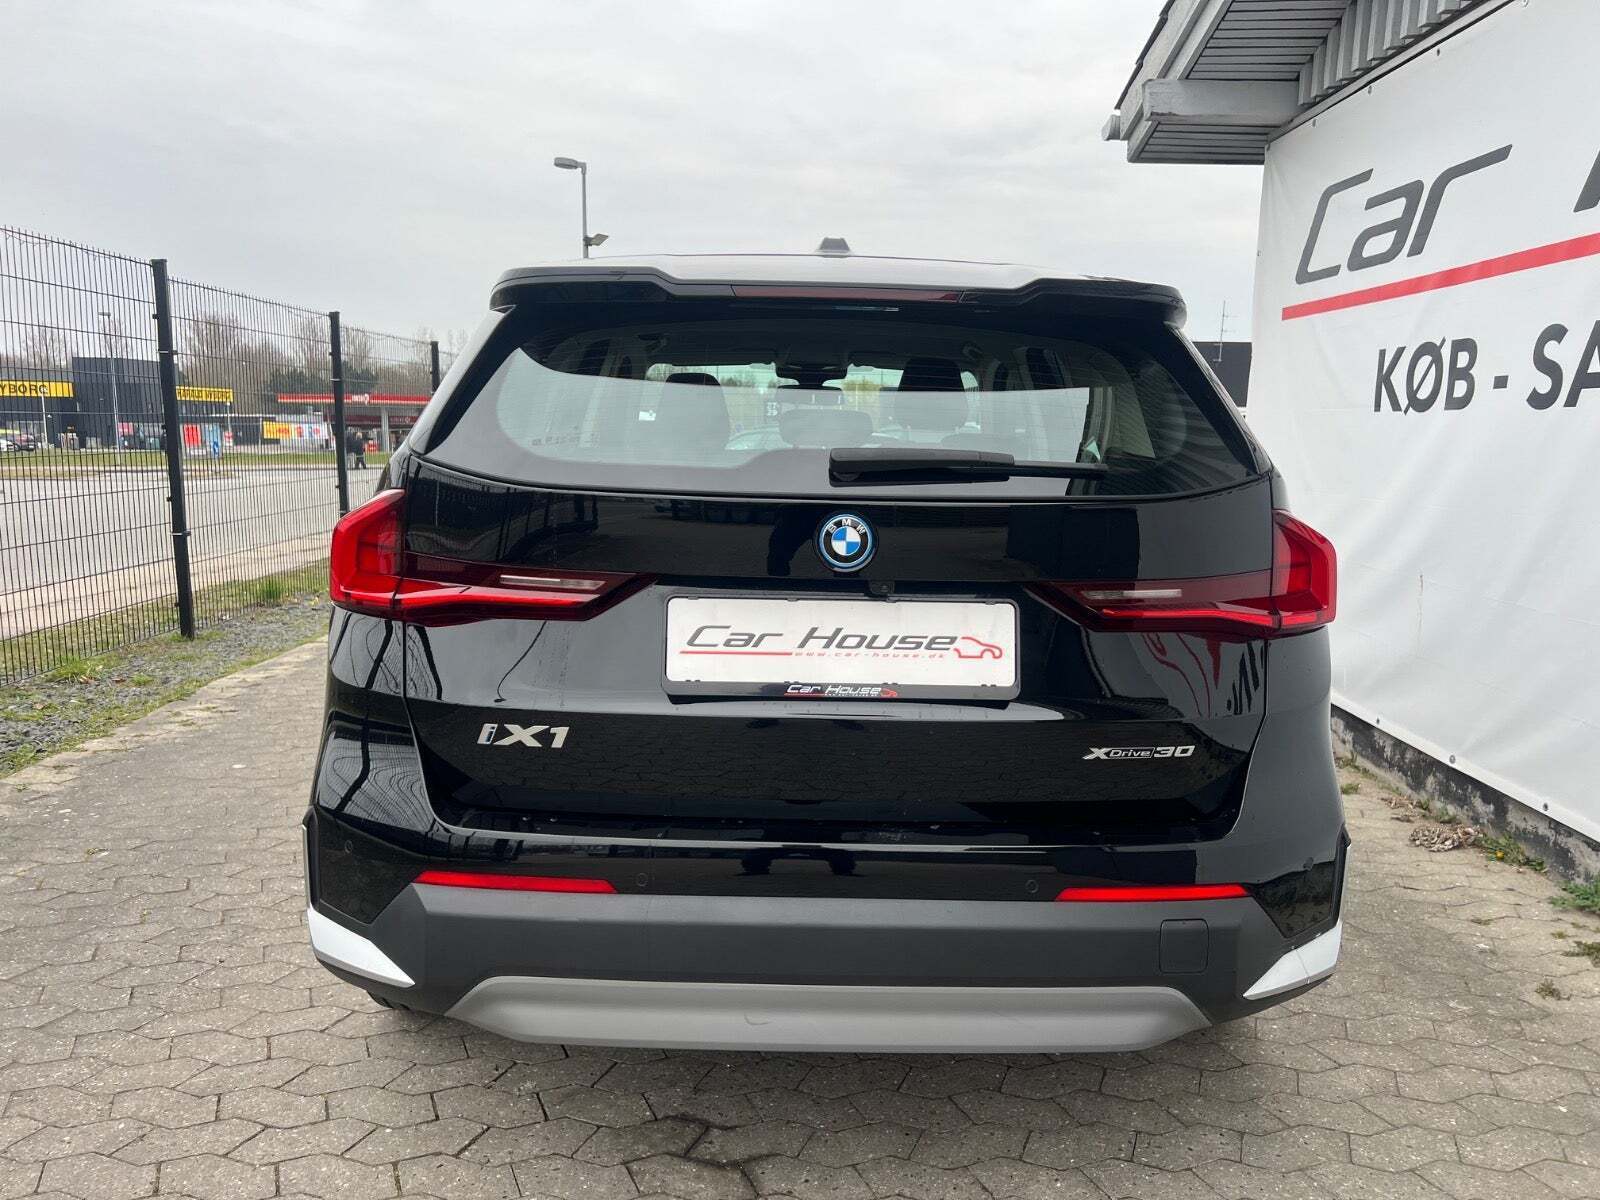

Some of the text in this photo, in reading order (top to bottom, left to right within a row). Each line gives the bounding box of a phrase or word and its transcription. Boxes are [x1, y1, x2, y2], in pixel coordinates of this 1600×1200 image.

[1295, 143, 1513, 285] Car
[1374, 336, 1478, 415] KØB
[827, 518, 867, 536] BMW
[686, 625, 958, 651] Car House
[786, 684, 821, 693] Car
[824, 685, 882, 695] House
